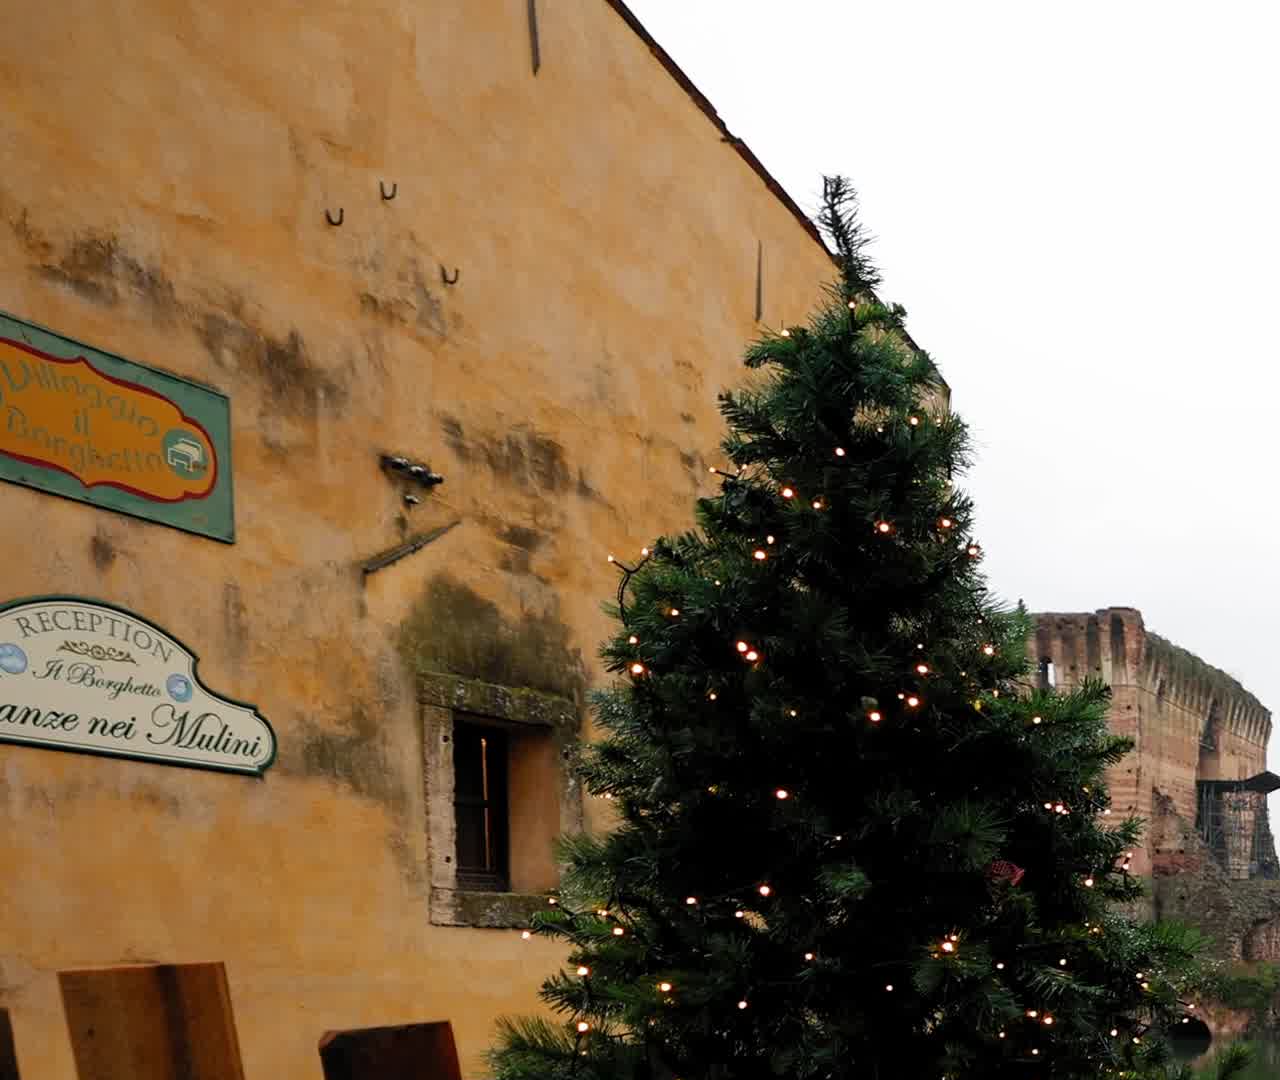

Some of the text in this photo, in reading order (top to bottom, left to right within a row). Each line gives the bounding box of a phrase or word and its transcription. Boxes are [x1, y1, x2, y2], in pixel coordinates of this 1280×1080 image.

[16, 610, 172, 663] RECEPTION
[32, 659, 162, 700] Il Borghetto
[88, 716, 137, 740] nei
[147, 703, 262, 758] Mulini
